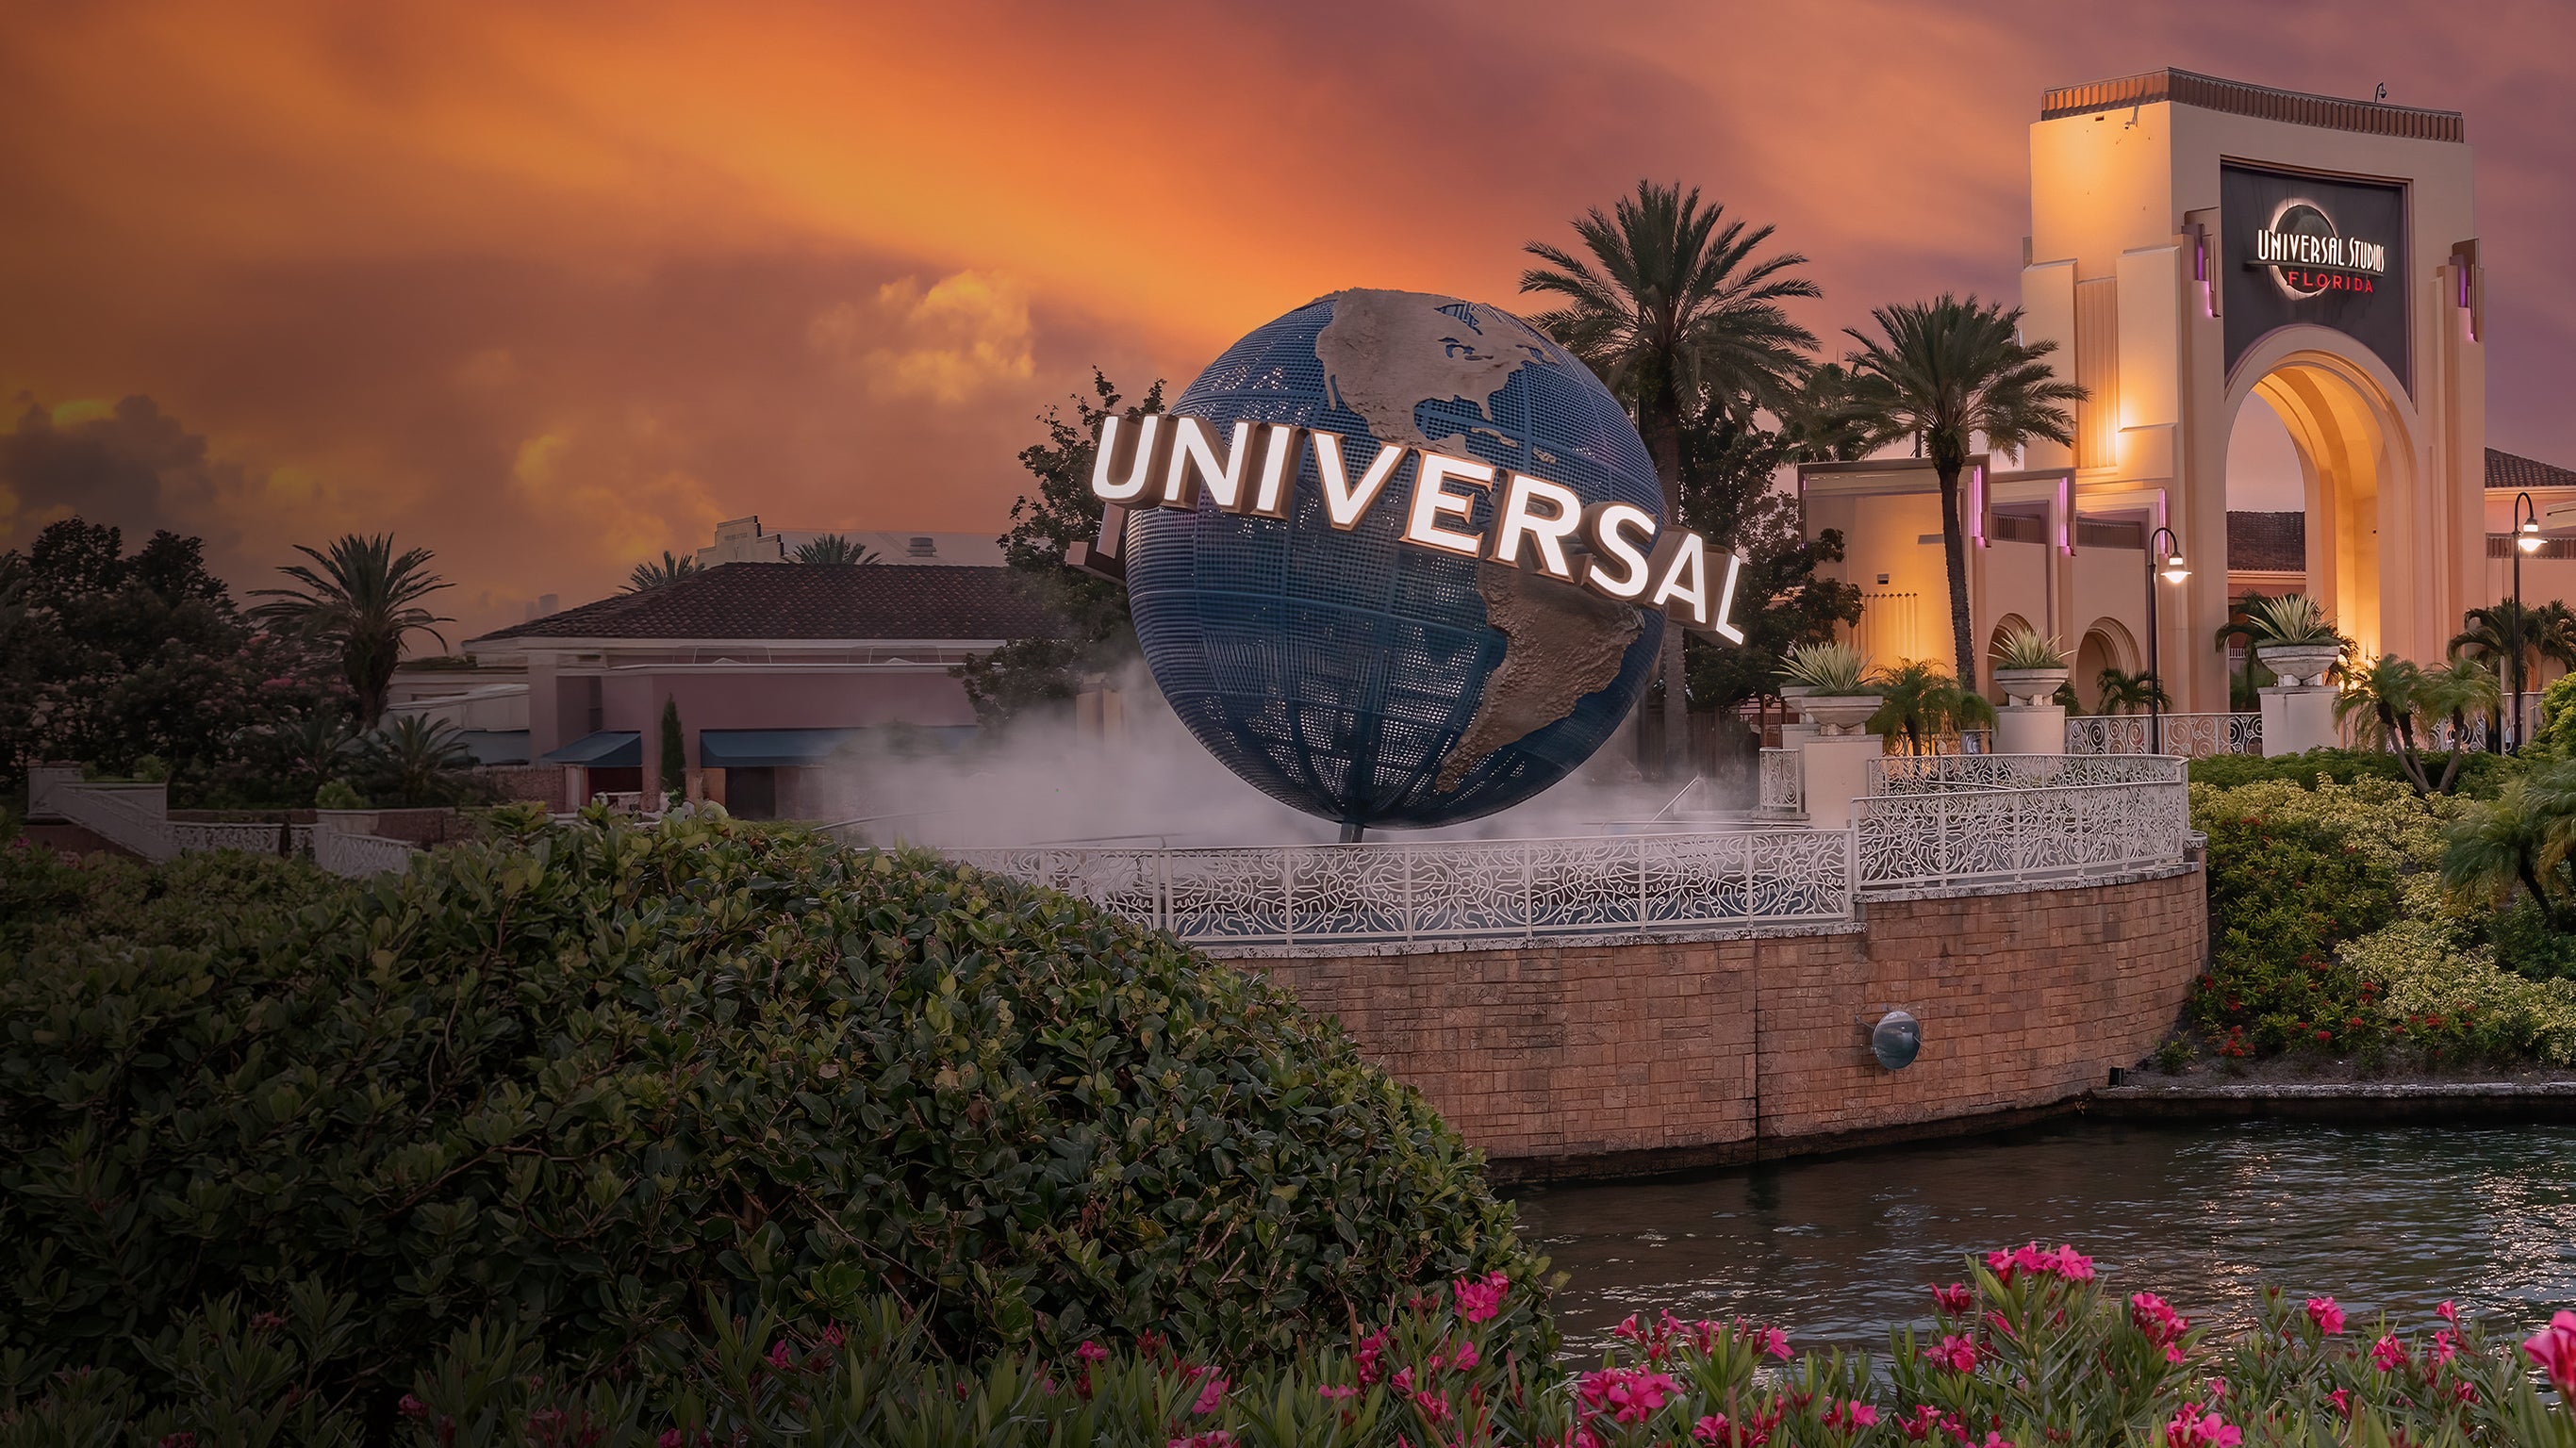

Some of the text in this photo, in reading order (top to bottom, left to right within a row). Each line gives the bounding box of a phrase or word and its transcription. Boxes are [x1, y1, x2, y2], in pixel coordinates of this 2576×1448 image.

[2257, 229, 2385, 272] UNIVERSAL STUDIOS
[2287, 272, 2373, 293] FLORIDA
[1090, 415, 1745, 646] UNIVERSAL
